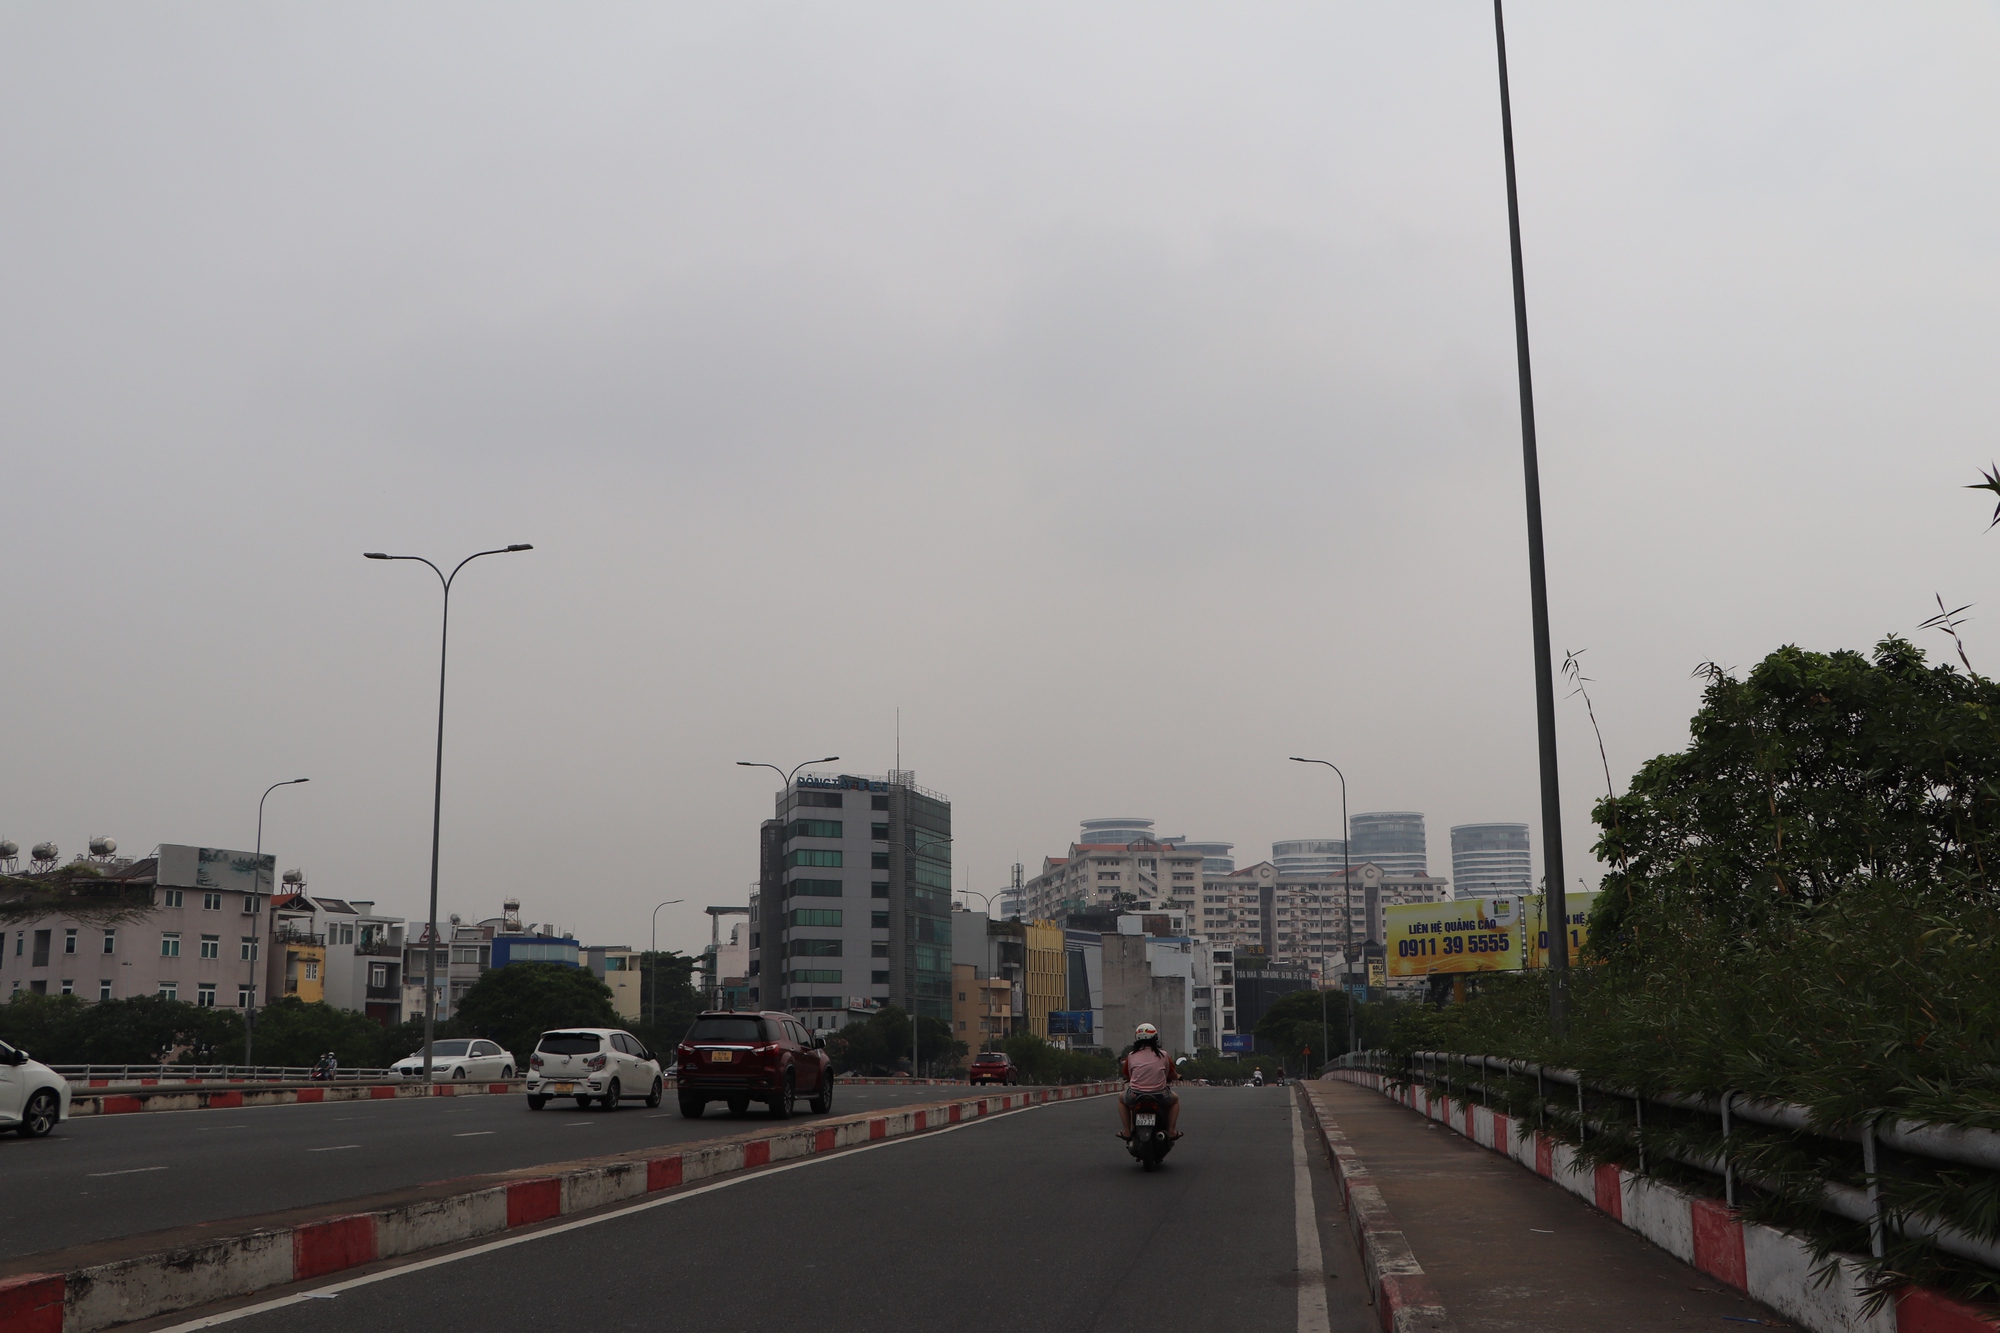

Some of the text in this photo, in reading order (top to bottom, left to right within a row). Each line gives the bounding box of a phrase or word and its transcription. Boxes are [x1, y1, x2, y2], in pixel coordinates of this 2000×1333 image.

[1409, 917, 1496, 935] LIÊN HỆ QUẢNG CÁO
[1399, 933, 1509, 957] 0911 39 5555
